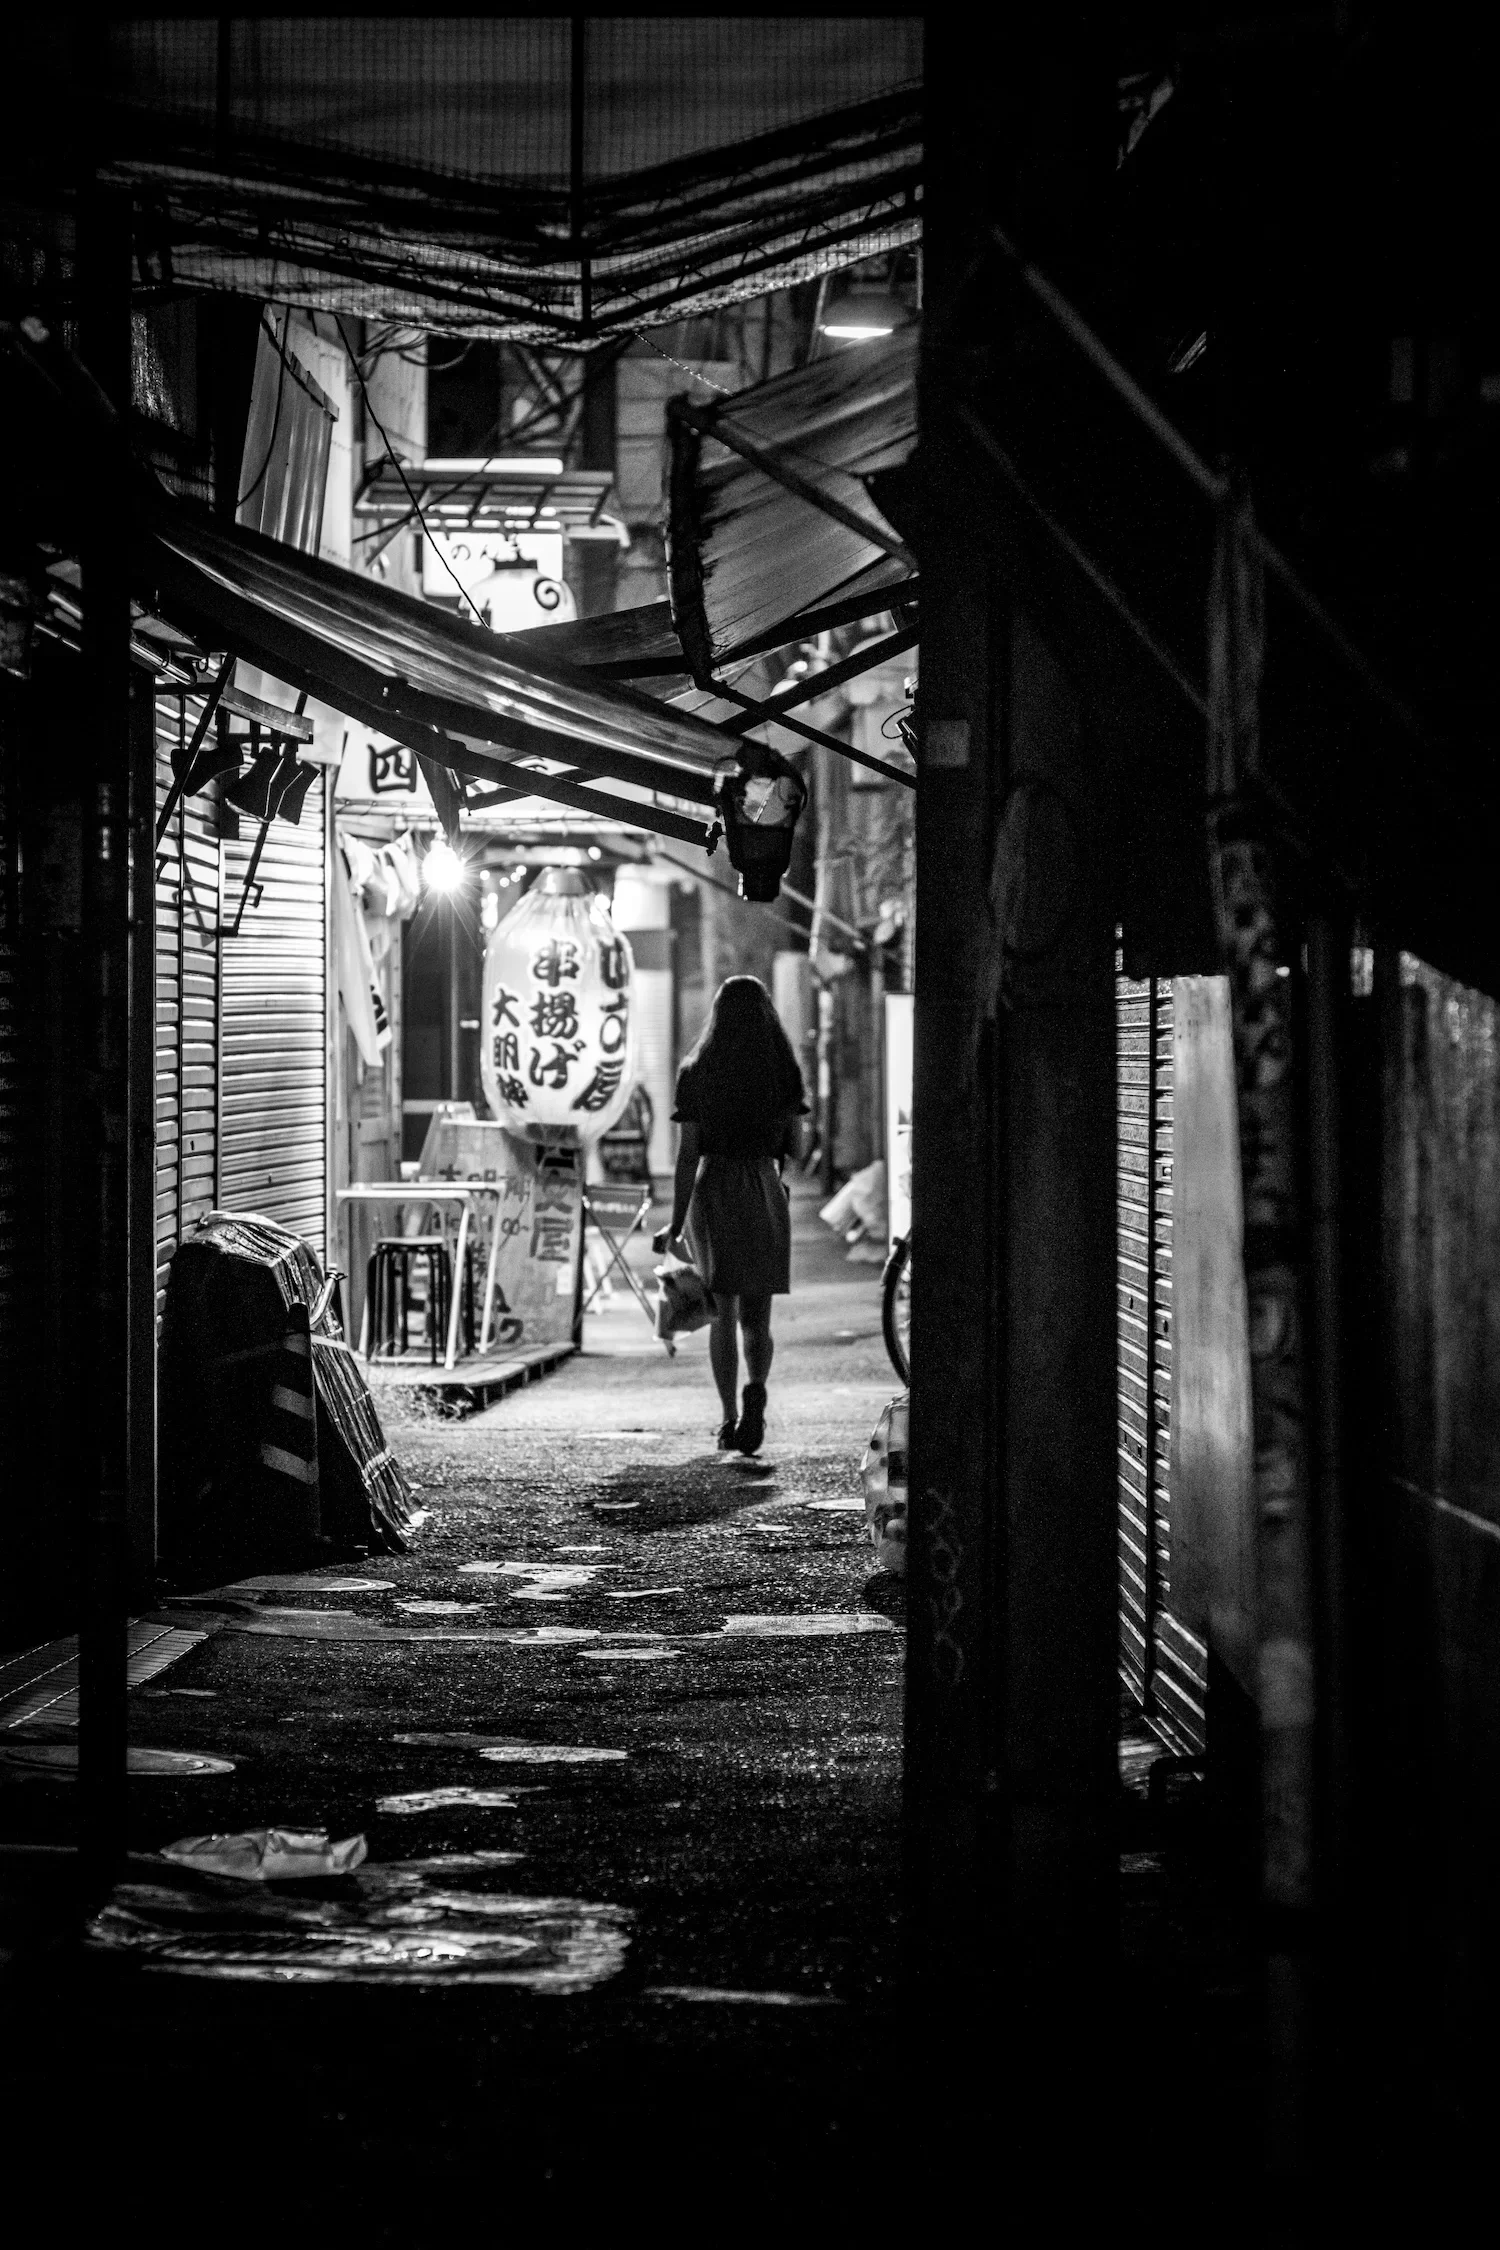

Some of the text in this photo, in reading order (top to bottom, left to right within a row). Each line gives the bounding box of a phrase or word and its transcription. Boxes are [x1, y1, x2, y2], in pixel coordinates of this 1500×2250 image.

[366, 743, 418, 793] 四
[528, 938, 587, 1090] 串揚げ
